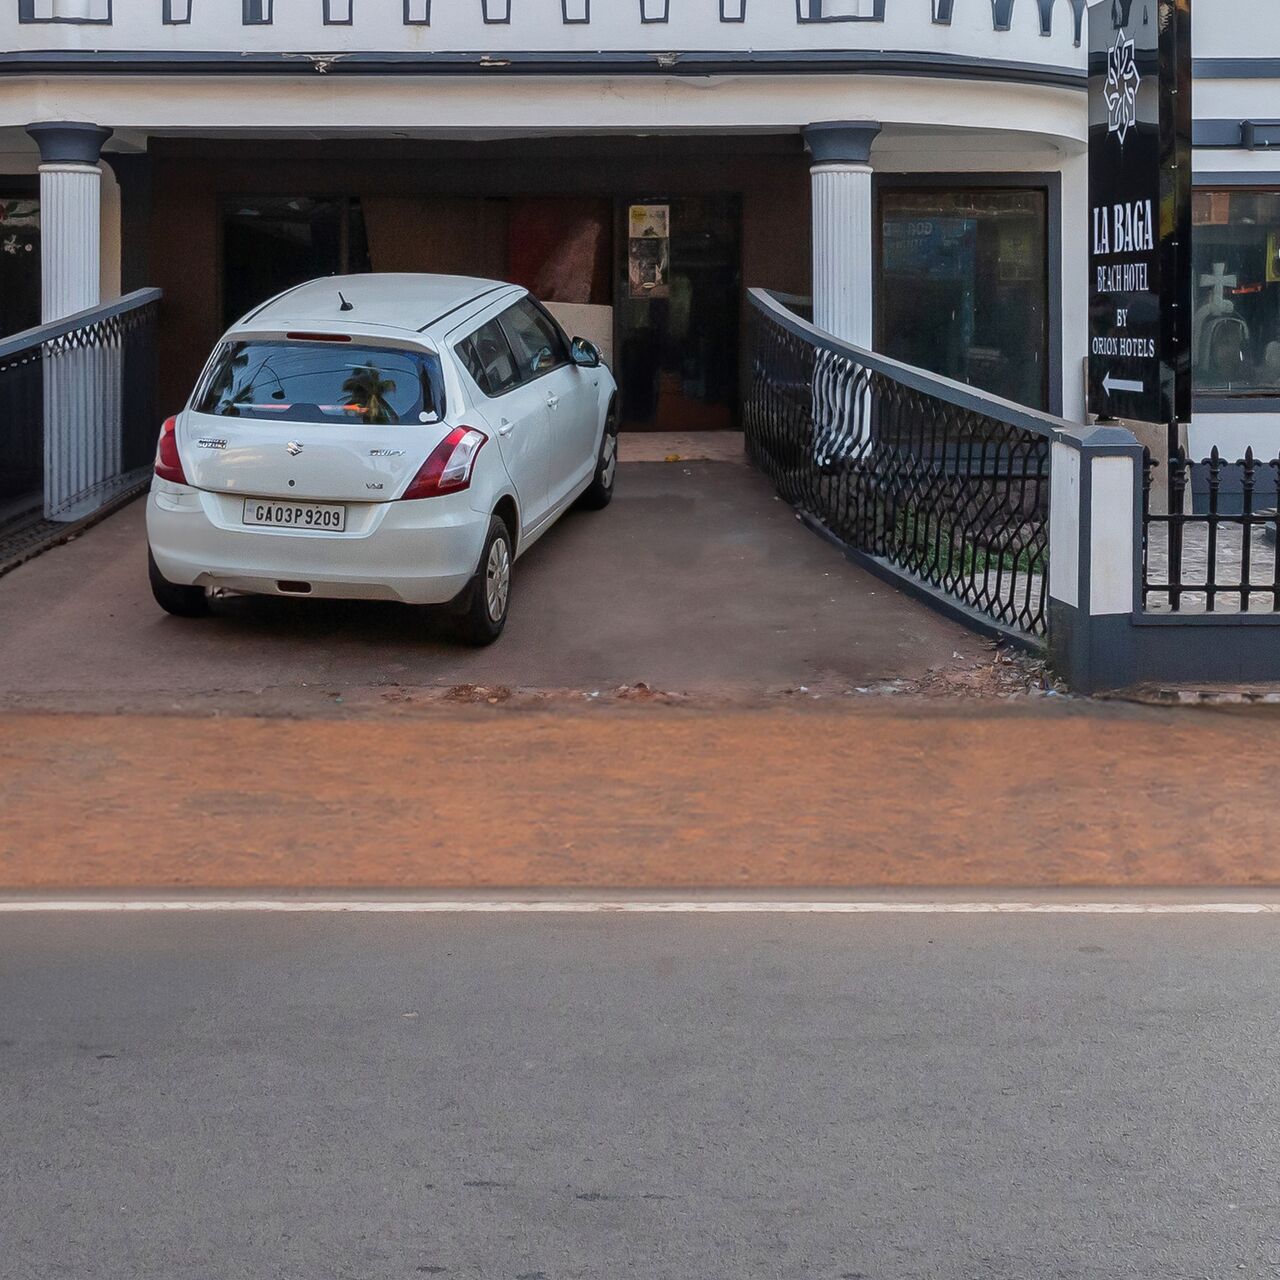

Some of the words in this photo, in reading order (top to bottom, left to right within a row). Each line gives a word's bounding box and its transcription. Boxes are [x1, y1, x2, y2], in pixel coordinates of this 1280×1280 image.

[1093, 206, 1110, 255] LA
[1113, 199, 1154, 253] BAGA
[1097, 264, 1122, 293] BEACH
[1123, 263, 1149, 292] HOTEL
[1116, 308, 1128, 327] BY
[1092, 337, 1118, 355] ORION
[1120, 337, 1155, 358] HOTELS
[255, 505, 340, 527] GA03P9209
